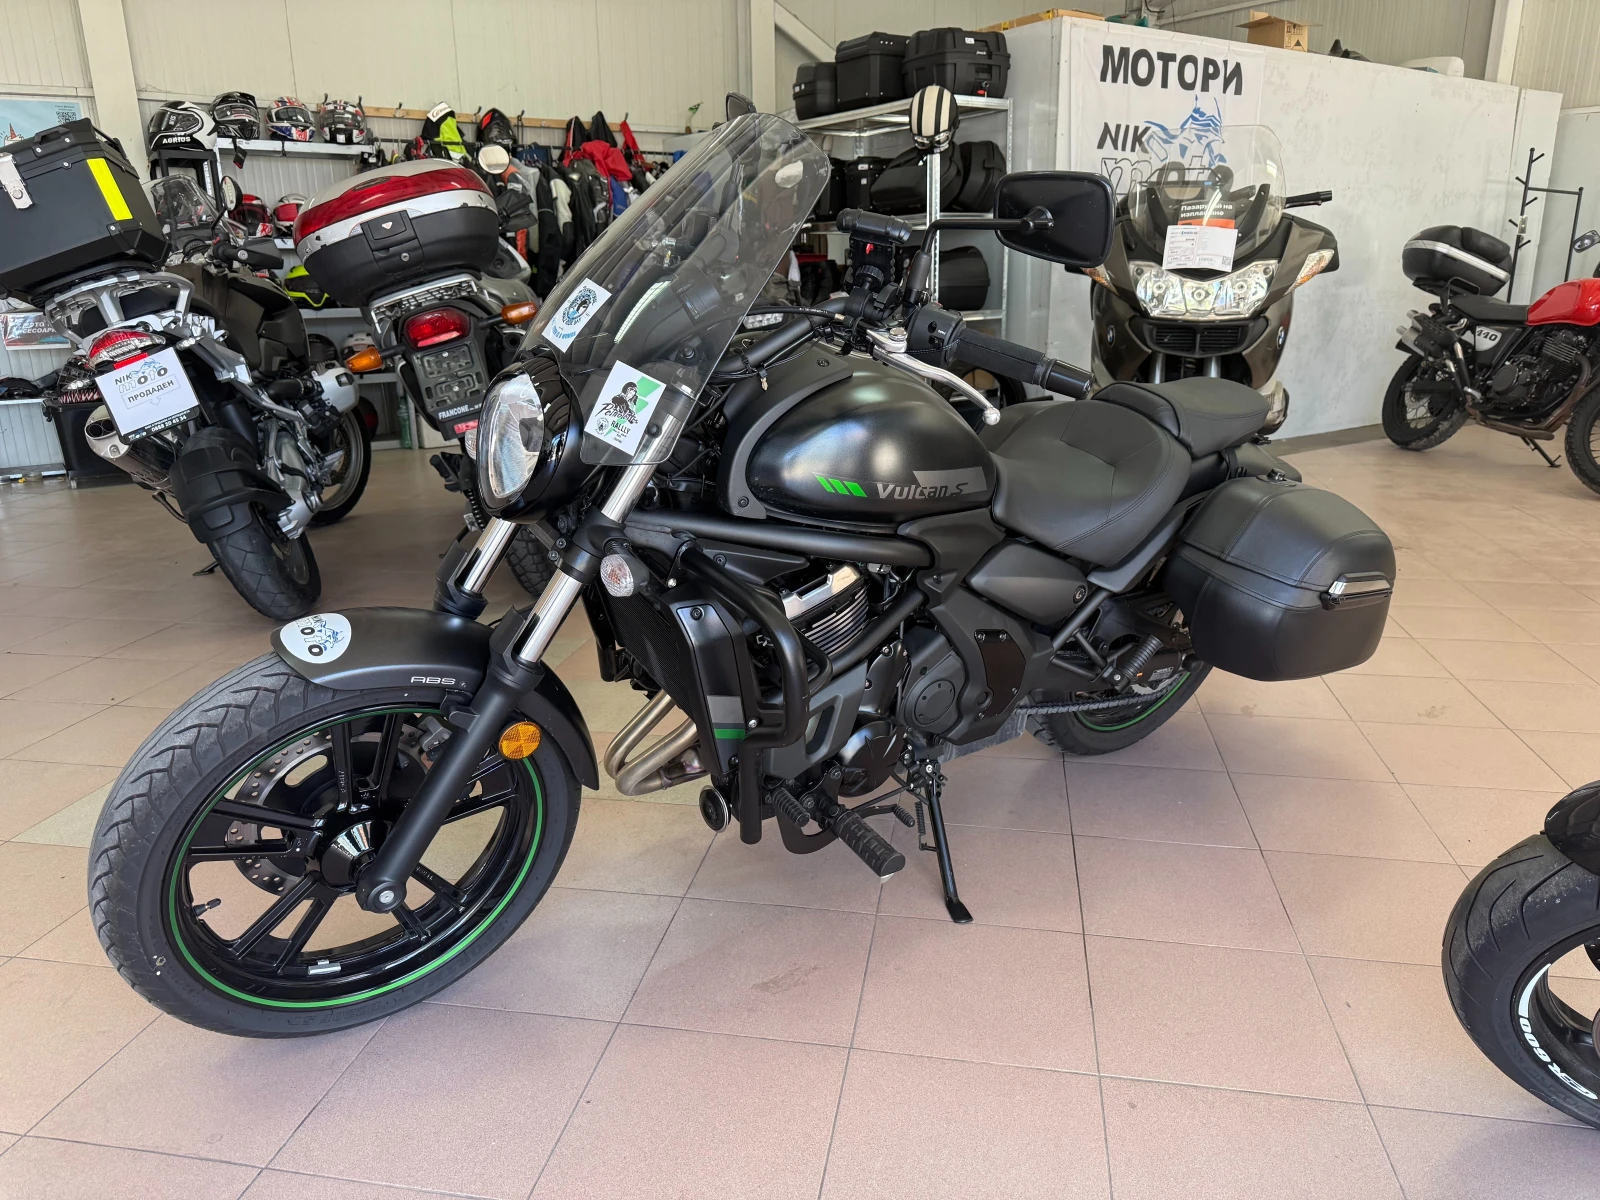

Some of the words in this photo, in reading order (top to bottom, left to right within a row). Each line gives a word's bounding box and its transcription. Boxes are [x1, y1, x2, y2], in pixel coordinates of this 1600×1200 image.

[1100, 44, 1243, 96] МОТОРИ
[1097, 122, 1152, 154] NIK
[115, 372, 132, 385] NIK
[118, 367, 168, 393] moto
[128, 379, 174, 403] ПРОДАДЕН
[438, 404, 470, 420] FRANCONE
[875, 482, 949, 500] Vulcan
[953, 482, 969, 496] S
[411, 676, 456, 685] ABS
